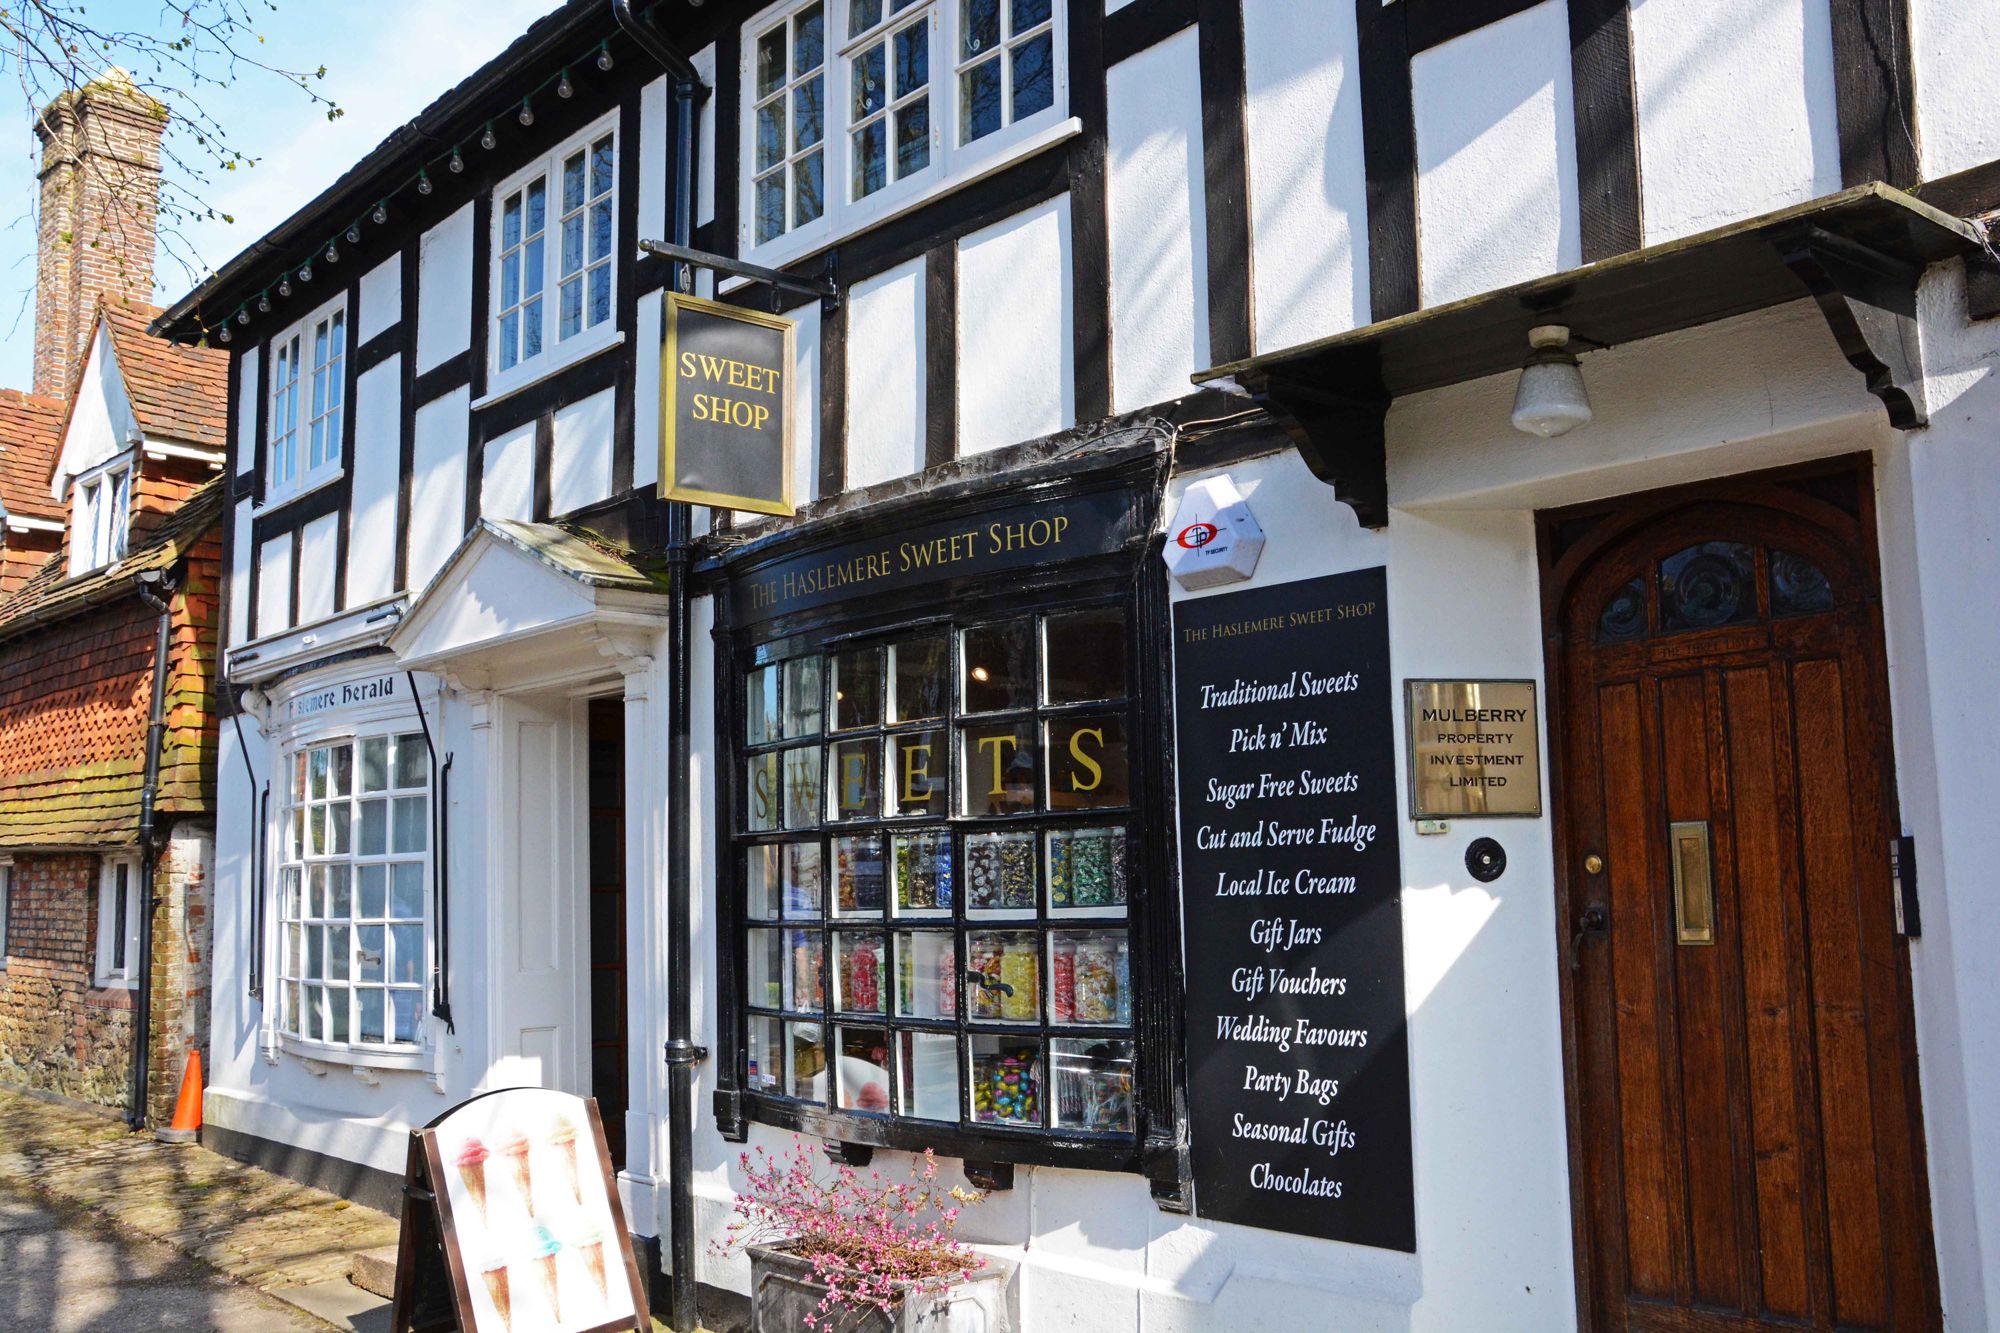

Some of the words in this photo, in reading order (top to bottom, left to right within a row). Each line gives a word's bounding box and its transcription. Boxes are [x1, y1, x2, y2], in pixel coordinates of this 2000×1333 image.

[681, 351, 780, 395] SWEET
[692, 393, 769, 430] SHOP
[751, 581, 777, 609] THE
[783, 551, 891, 601] HASLEMERE
[900, 531, 978, 574] SWEET
[988, 516, 1069, 554] SHOP
[1184, 628, 1207, 643] THE
[1212, 616, 1285, 639] HASLEMERE
[1289, 608, 1332, 626] SWEET
[1338, 601, 1376, 619] SHOP
[1201, 672, 1296, 709] Traditional
[1300, 671, 1359, 697] Sweets
[1422, 709, 1527, 723] MULBERRY
[1229, 724, 1266, 753] Pick
[1289, 721, 1328, 747] Mix
[1437, 733, 1514, 744] PROPERTY
[754, 727, 1104, 820] SWEETS
[1430, 755, 1524, 766] INVESTMENT
[1206, 778, 1254, 809] Sugar
[1257, 773, 1294, 798] Free
[1299, 770, 1359, 796] Sweets
[1450, 776, 1507, 787] LIMITED
[1197, 825, 1227, 850] Cut
[1229, 820, 1263, 848] and
[1267, 821, 1314, 847] Serve
[1318, 814, 1376, 852] Fudge
[1216, 869, 1264, 896] Local
[1265, 870, 1289, 895] Ice
[1295, 869, 1356, 895] Cream
[1250, 917, 1283, 952] Gift
[1284, 919, 1322, 951] Jars
[1231, 966, 1264, 1002] Gift
[1269, 967, 1347, 996] Vouchers
[1216, 1015, 1292, 1053] Wedding
[1293, 1019, 1368, 1048] Favours
[1243, 1065, 1291, 1102] Party
[1294, 1069, 1339, 1105] Bags
[1232, 1112, 1307, 1144] Seasonal
[1312, 1119, 1356, 1156] Gifts
[1250, 1163, 1343, 1199] Chocolates
